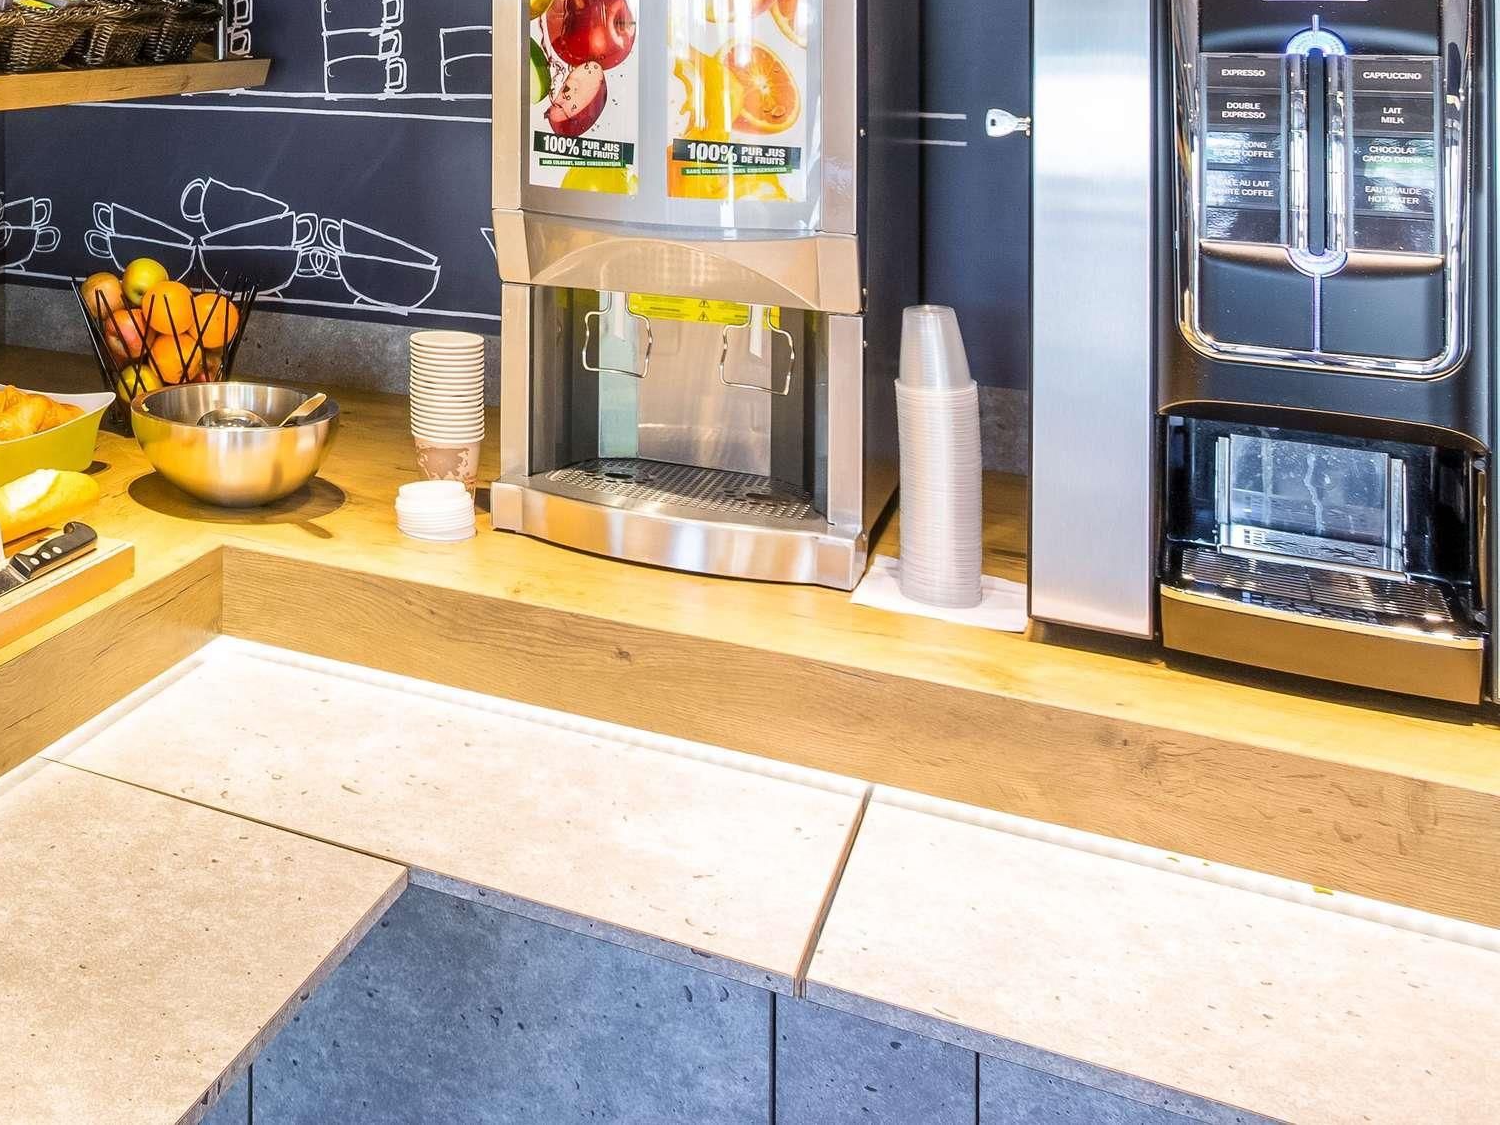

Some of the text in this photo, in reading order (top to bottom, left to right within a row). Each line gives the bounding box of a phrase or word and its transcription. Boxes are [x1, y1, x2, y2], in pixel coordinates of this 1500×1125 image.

[1221, 69, 1266, 77] EXPRESSO
[1363, 71, 1422, 80] CAPPUCCINO
[1226, 102, 1260, 110] DOUBLE
[1222, 111, 1266, 119] EXPRESSO
[1380, 116, 1404, 124] MILK
[543, 135, 580, 156] 100%
[582, 140, 620, 152] PUR JUS
[1369, 146, 1417, 154] CHOCOLAT
[582, 149, 619, 160] DE FRUITS
[687, 142, 738, 163] 100%
[741, 146, 786, 158] PUR JUS
[1242, 150, 1274, 159] COFFEE
[741, 155, 785, 166] DE FRUITS
[1362, 155, 1392, 163] CACAO
[1240, 179, 1251, 187] AU
[1253, 180, 1270, 188] LAIT
[1242, 189, 1274, 197] COFFEE
